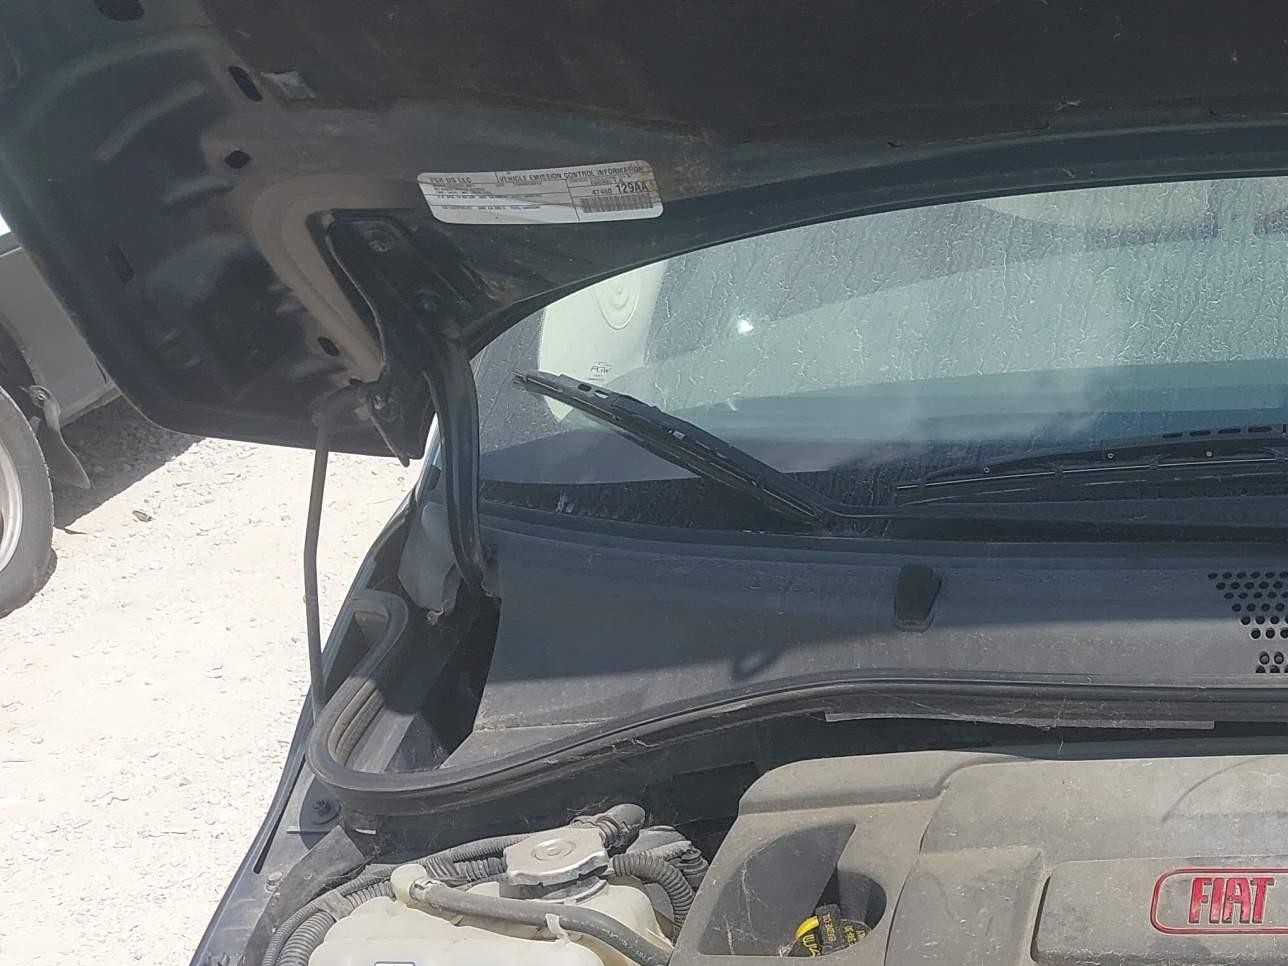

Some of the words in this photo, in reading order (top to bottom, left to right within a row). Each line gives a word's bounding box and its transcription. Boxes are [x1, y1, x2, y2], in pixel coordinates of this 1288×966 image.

[499, 175, 527, 183] VEHICLE
[529, 172, 562, 182] EMISSION
[564, 170, 595, 179] CONTROL
[596, 166, 643, 177] INFORMATION
[615, 181, 649, 194] 129AA
[1188, 876, 1276, 924] FIAT
